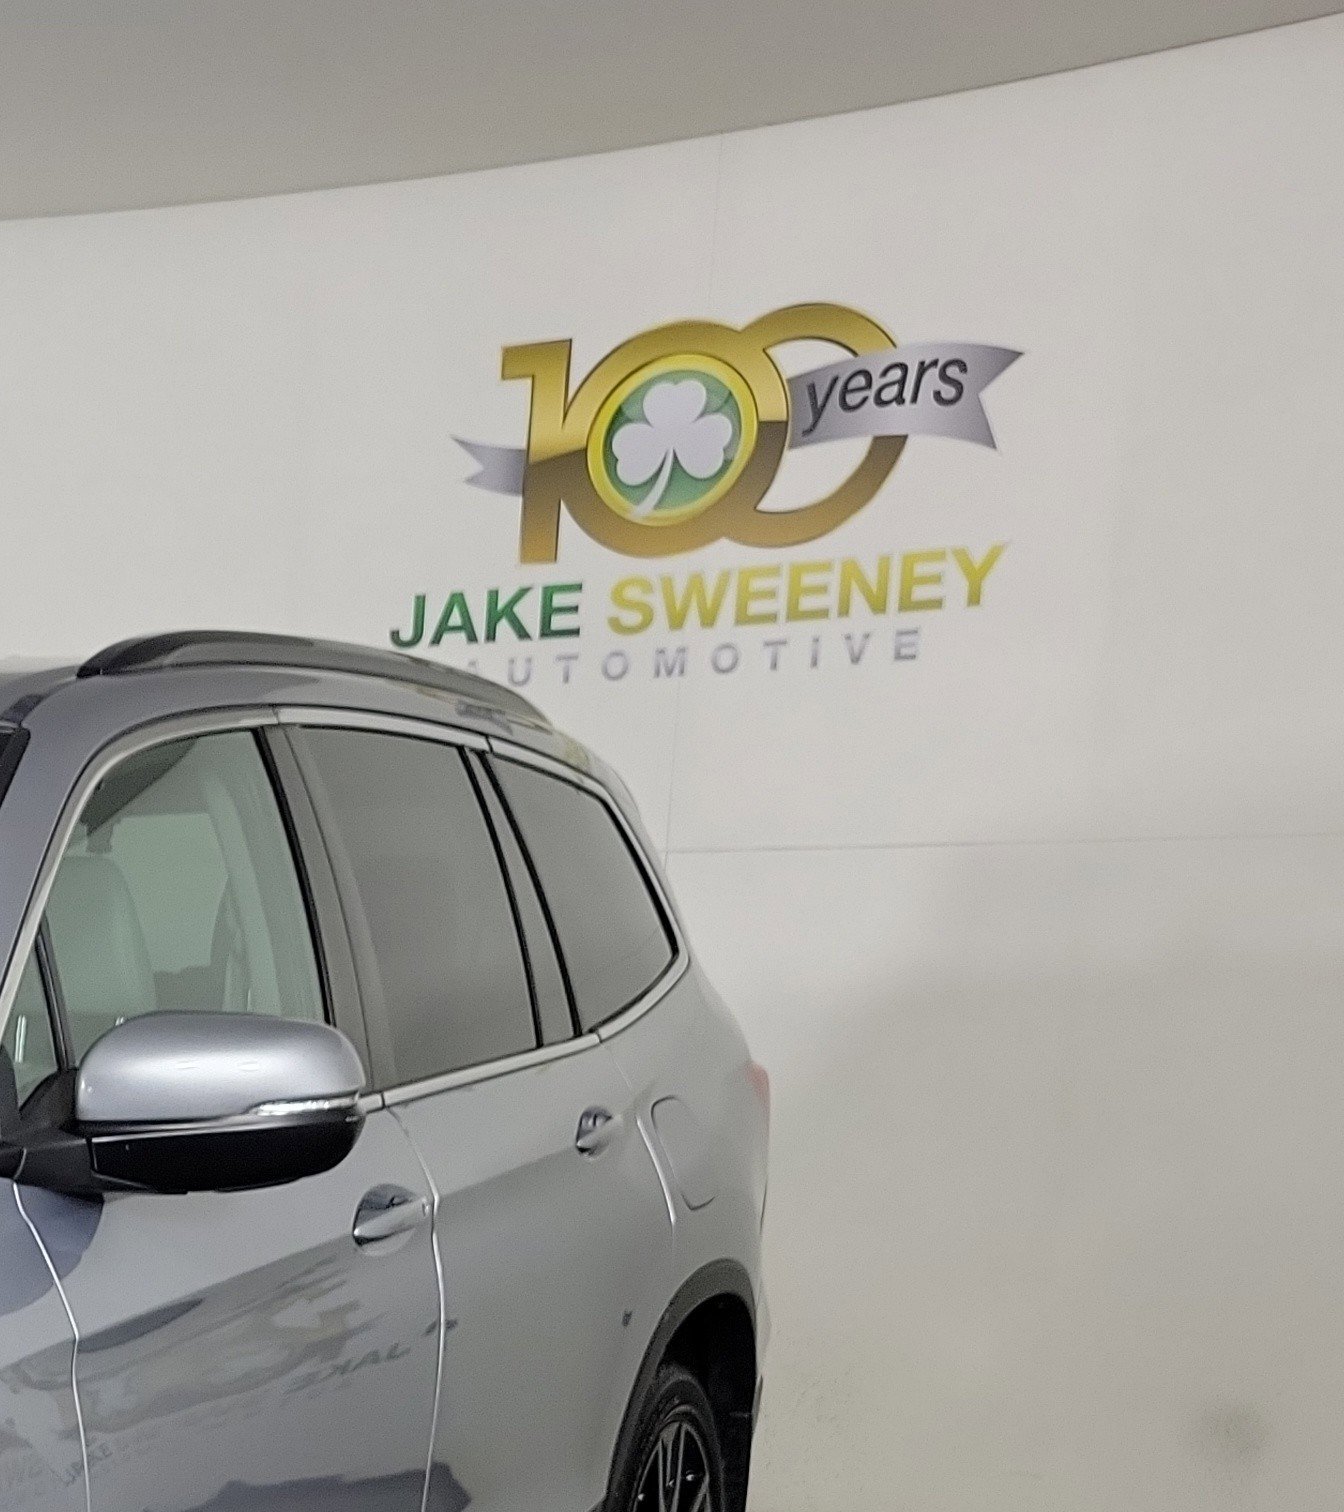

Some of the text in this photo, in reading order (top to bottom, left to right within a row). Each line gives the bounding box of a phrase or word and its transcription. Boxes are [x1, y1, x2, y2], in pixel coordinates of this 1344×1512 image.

[800, 355, 969, 437] years
[388, 542, 1009, 650] JAKE SWEENEY
